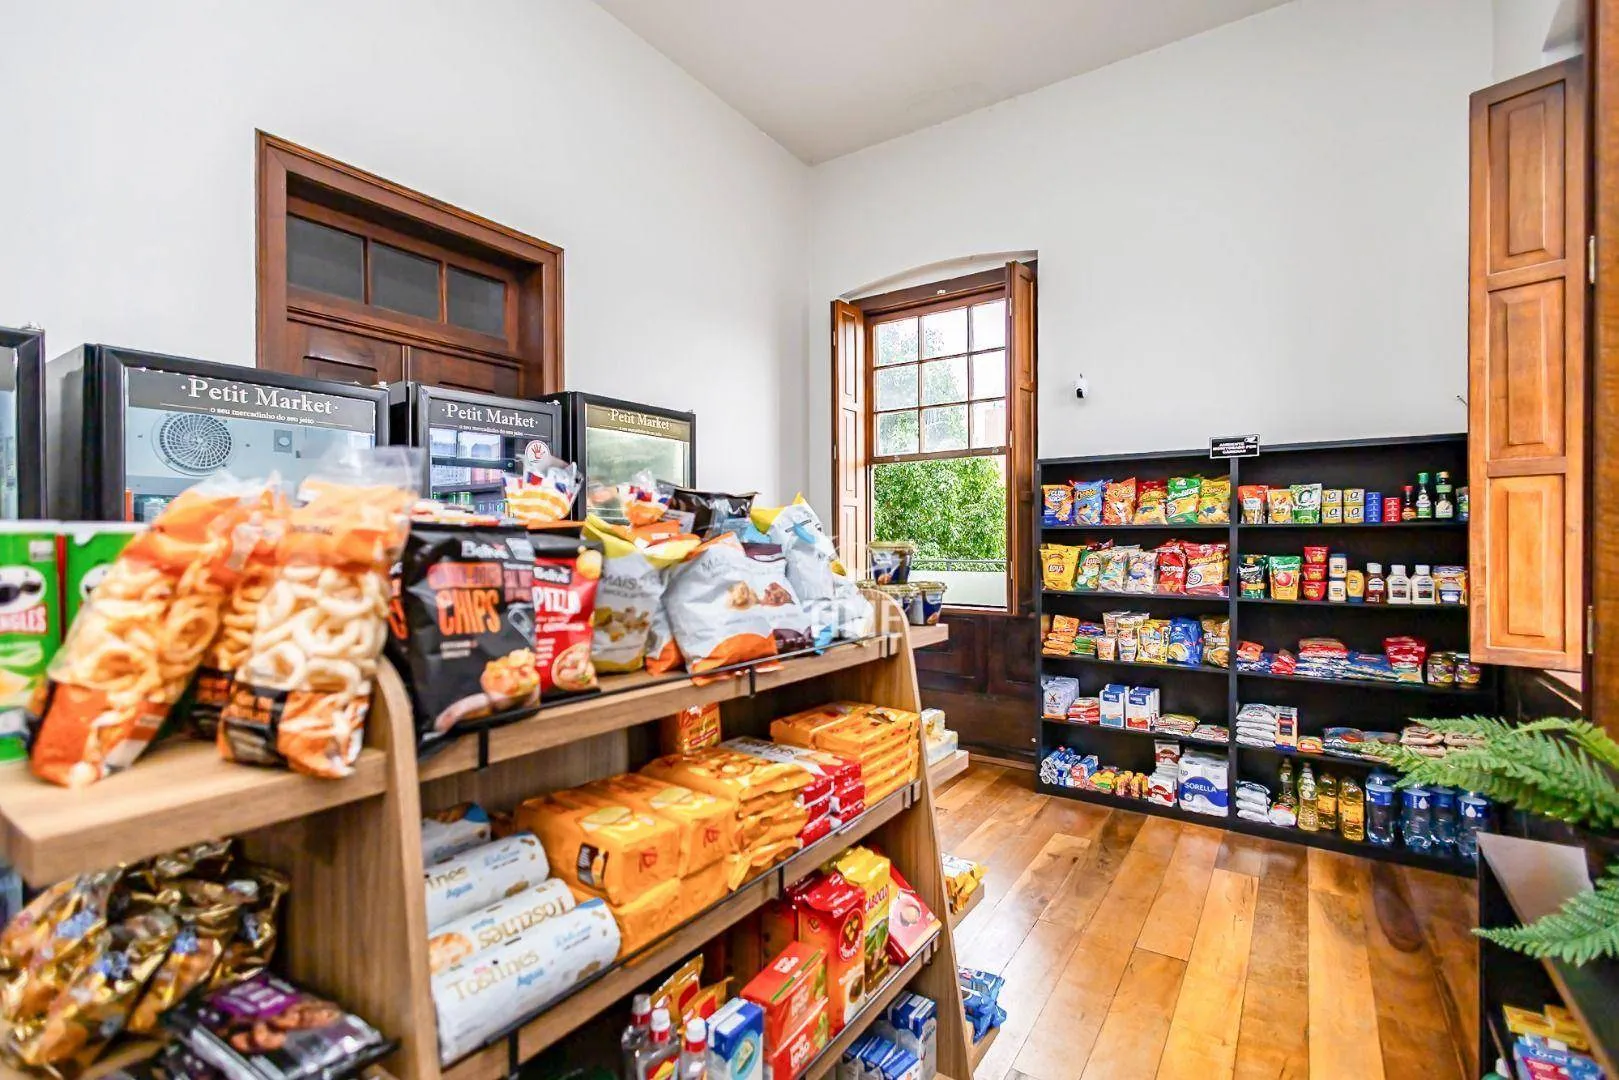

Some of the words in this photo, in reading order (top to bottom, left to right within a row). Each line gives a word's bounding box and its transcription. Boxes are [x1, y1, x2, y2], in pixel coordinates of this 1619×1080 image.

[187, 377, 249, 404] Petit
[255, 385, 332, 415] Market
[232, 409, 275, 421] mercadinho
[446, 403, 482, 422] Petit
[486, 409, 535, 428] Market
[610, 408, 635, 424] Petit
[637, 413, 670, 430] Market
[438, 588, 500, 636] CHIPS
[1184, 782, 1217, 793] SORELLA
